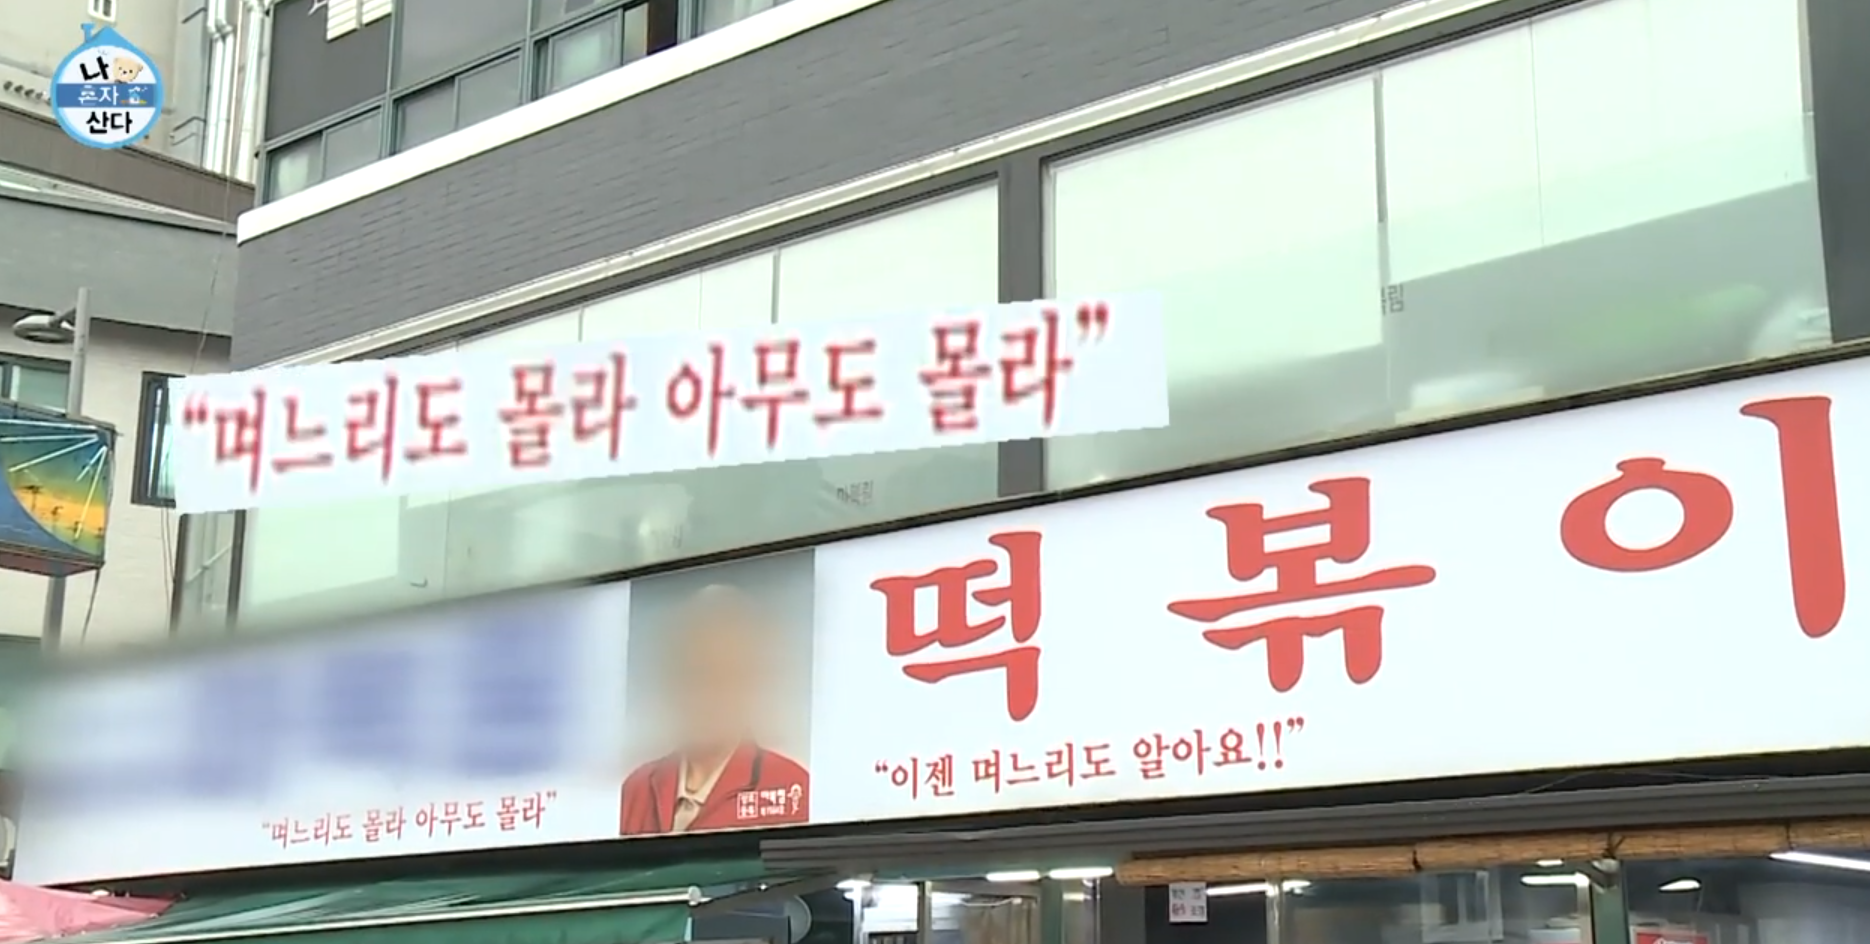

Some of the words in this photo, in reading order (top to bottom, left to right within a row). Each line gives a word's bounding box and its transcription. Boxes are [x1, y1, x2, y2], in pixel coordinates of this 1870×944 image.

[870, 396, 1846, 722] 떡볶이
[875, 754, 955, 800] “이젠
[972, 741, 1117, 795] 며느리도
[1133, 717, 1305, 780] 알아요!!”
[262, 812, 353, 849] “며느리도
[362, 806, 407, 842] 몰라
[415, 801, 486, 837] 아무도
[496, 790, 557, 831] 몰라”
